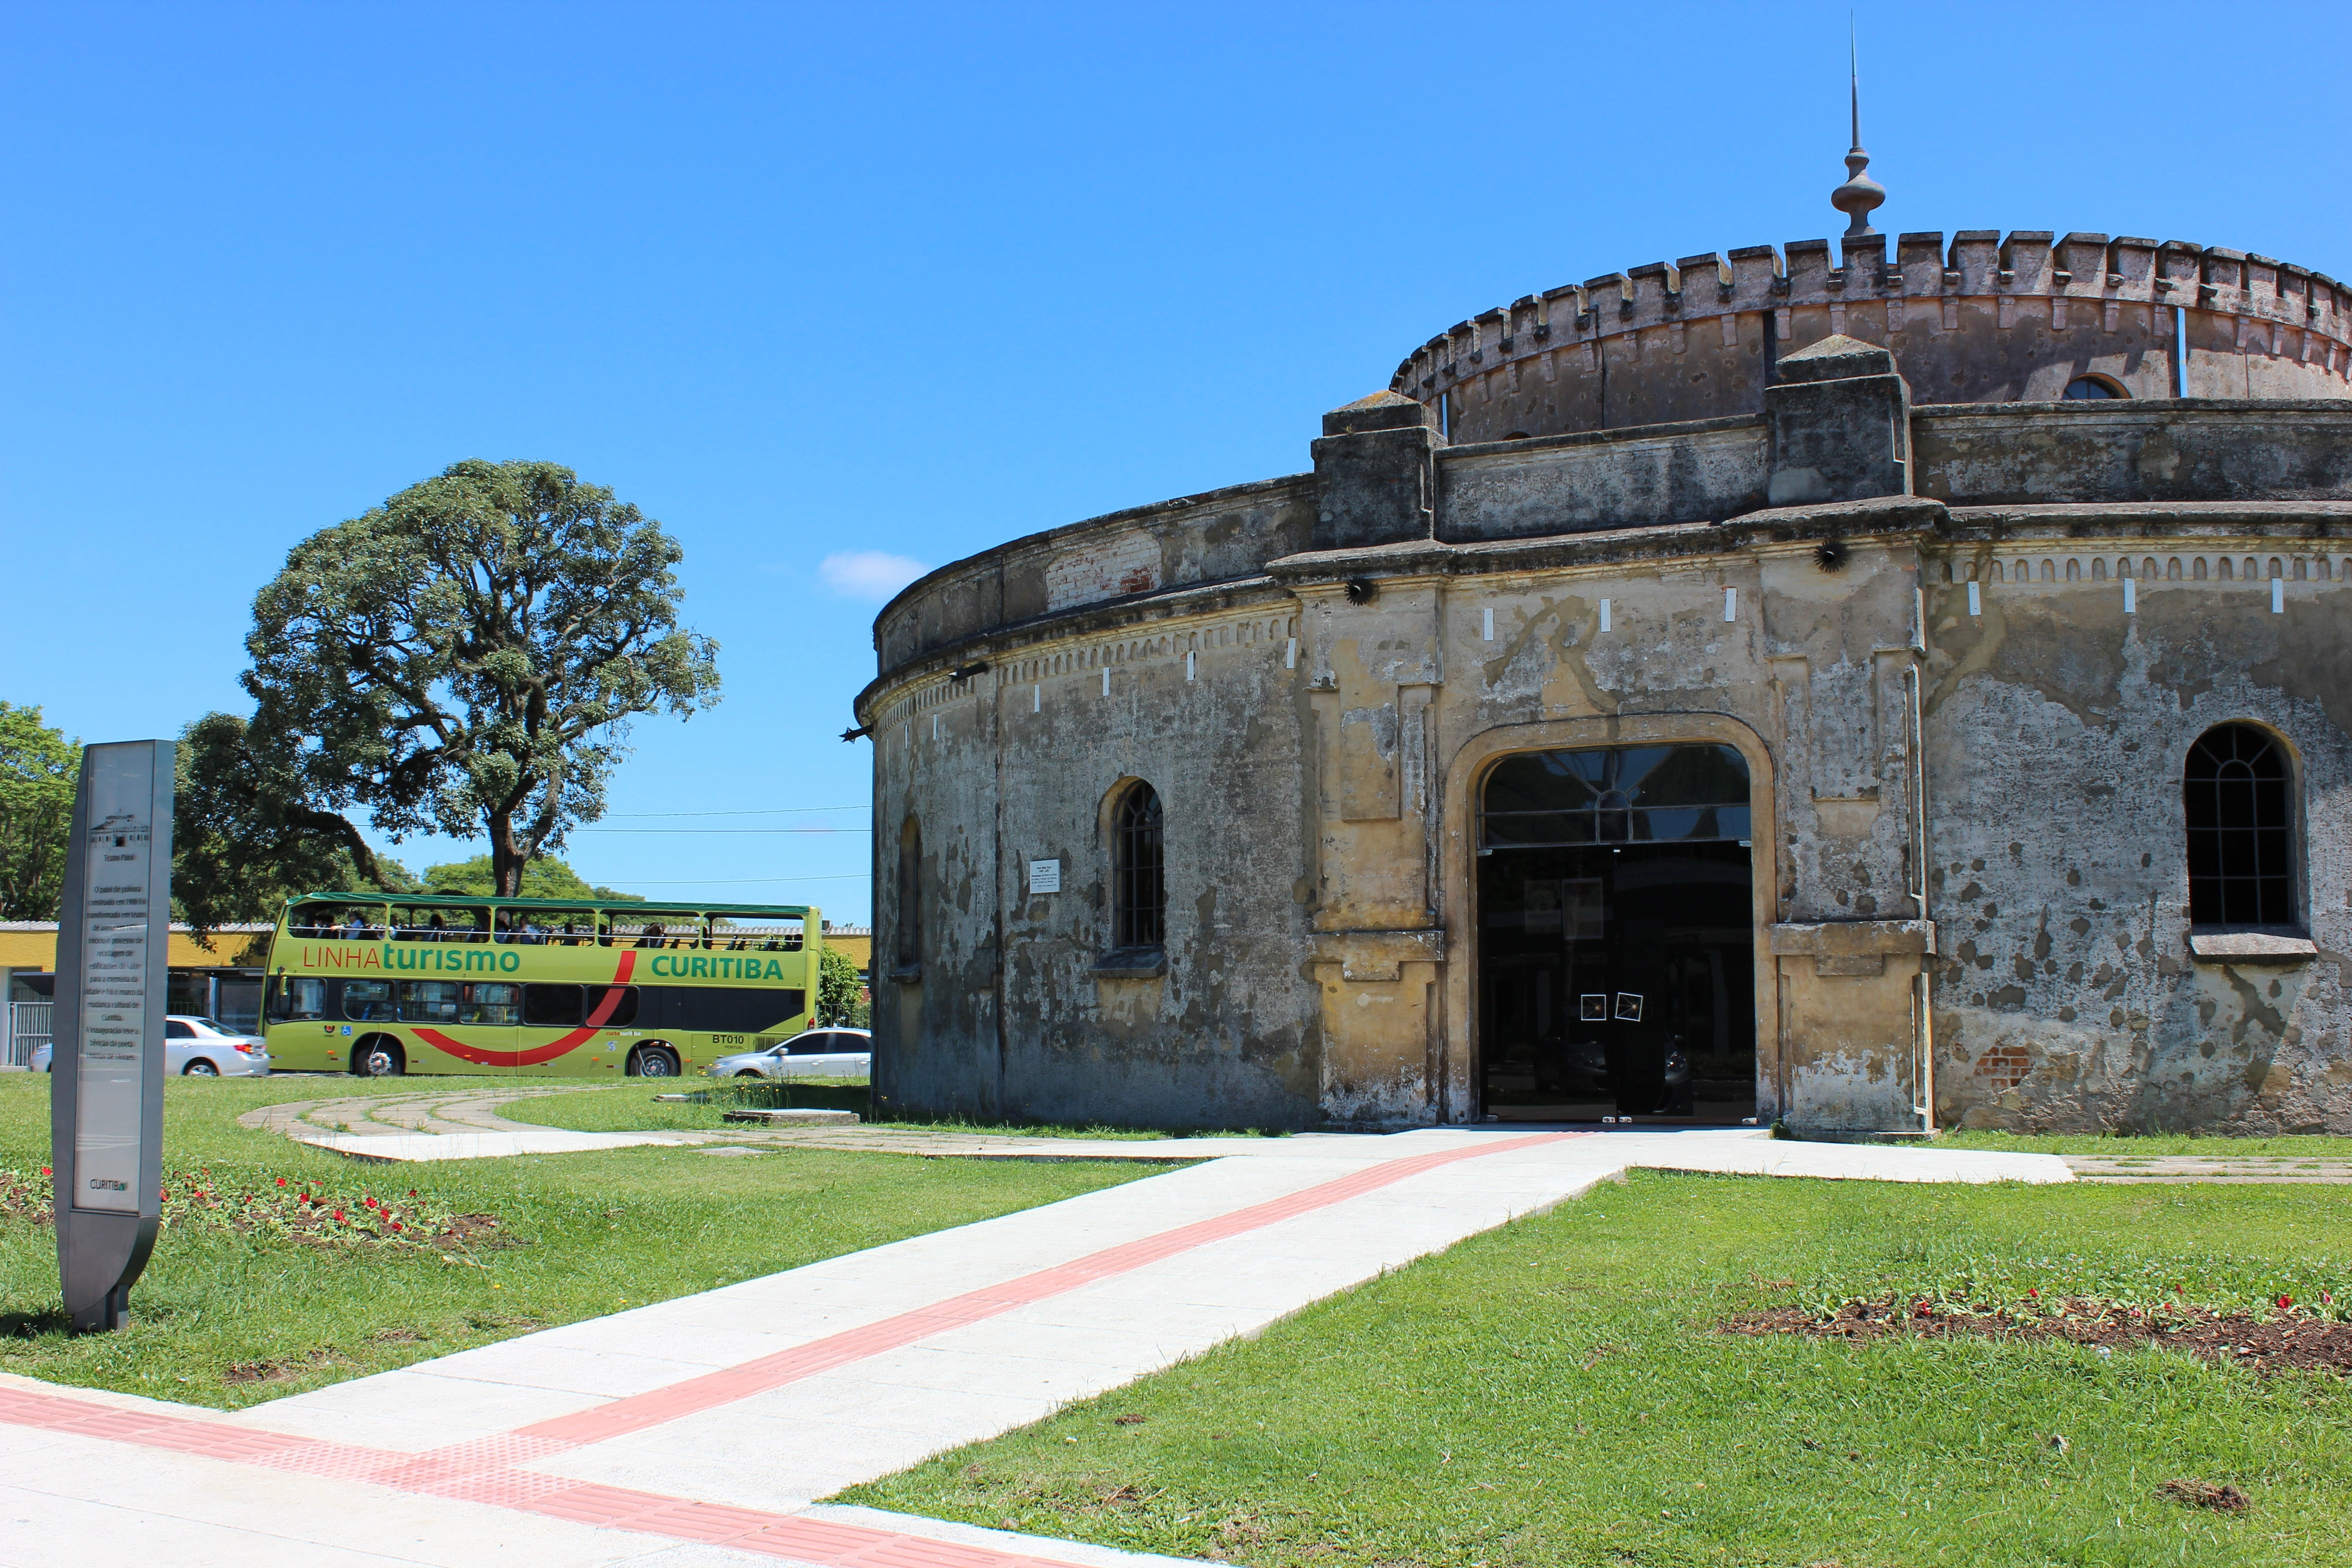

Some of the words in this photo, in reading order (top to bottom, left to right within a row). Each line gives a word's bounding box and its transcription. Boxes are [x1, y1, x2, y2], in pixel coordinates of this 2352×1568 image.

[97, 949, 125, 958] reciclagem
[652, 956, 784, 980] CURITIBA
[90, 1027, 122, 1035] inauguração
[90, 1039, 109, 1047] bênção
[712, 1035, 745, 1044] BT010
[90, 1179, 126, 1191] CURITIBA
